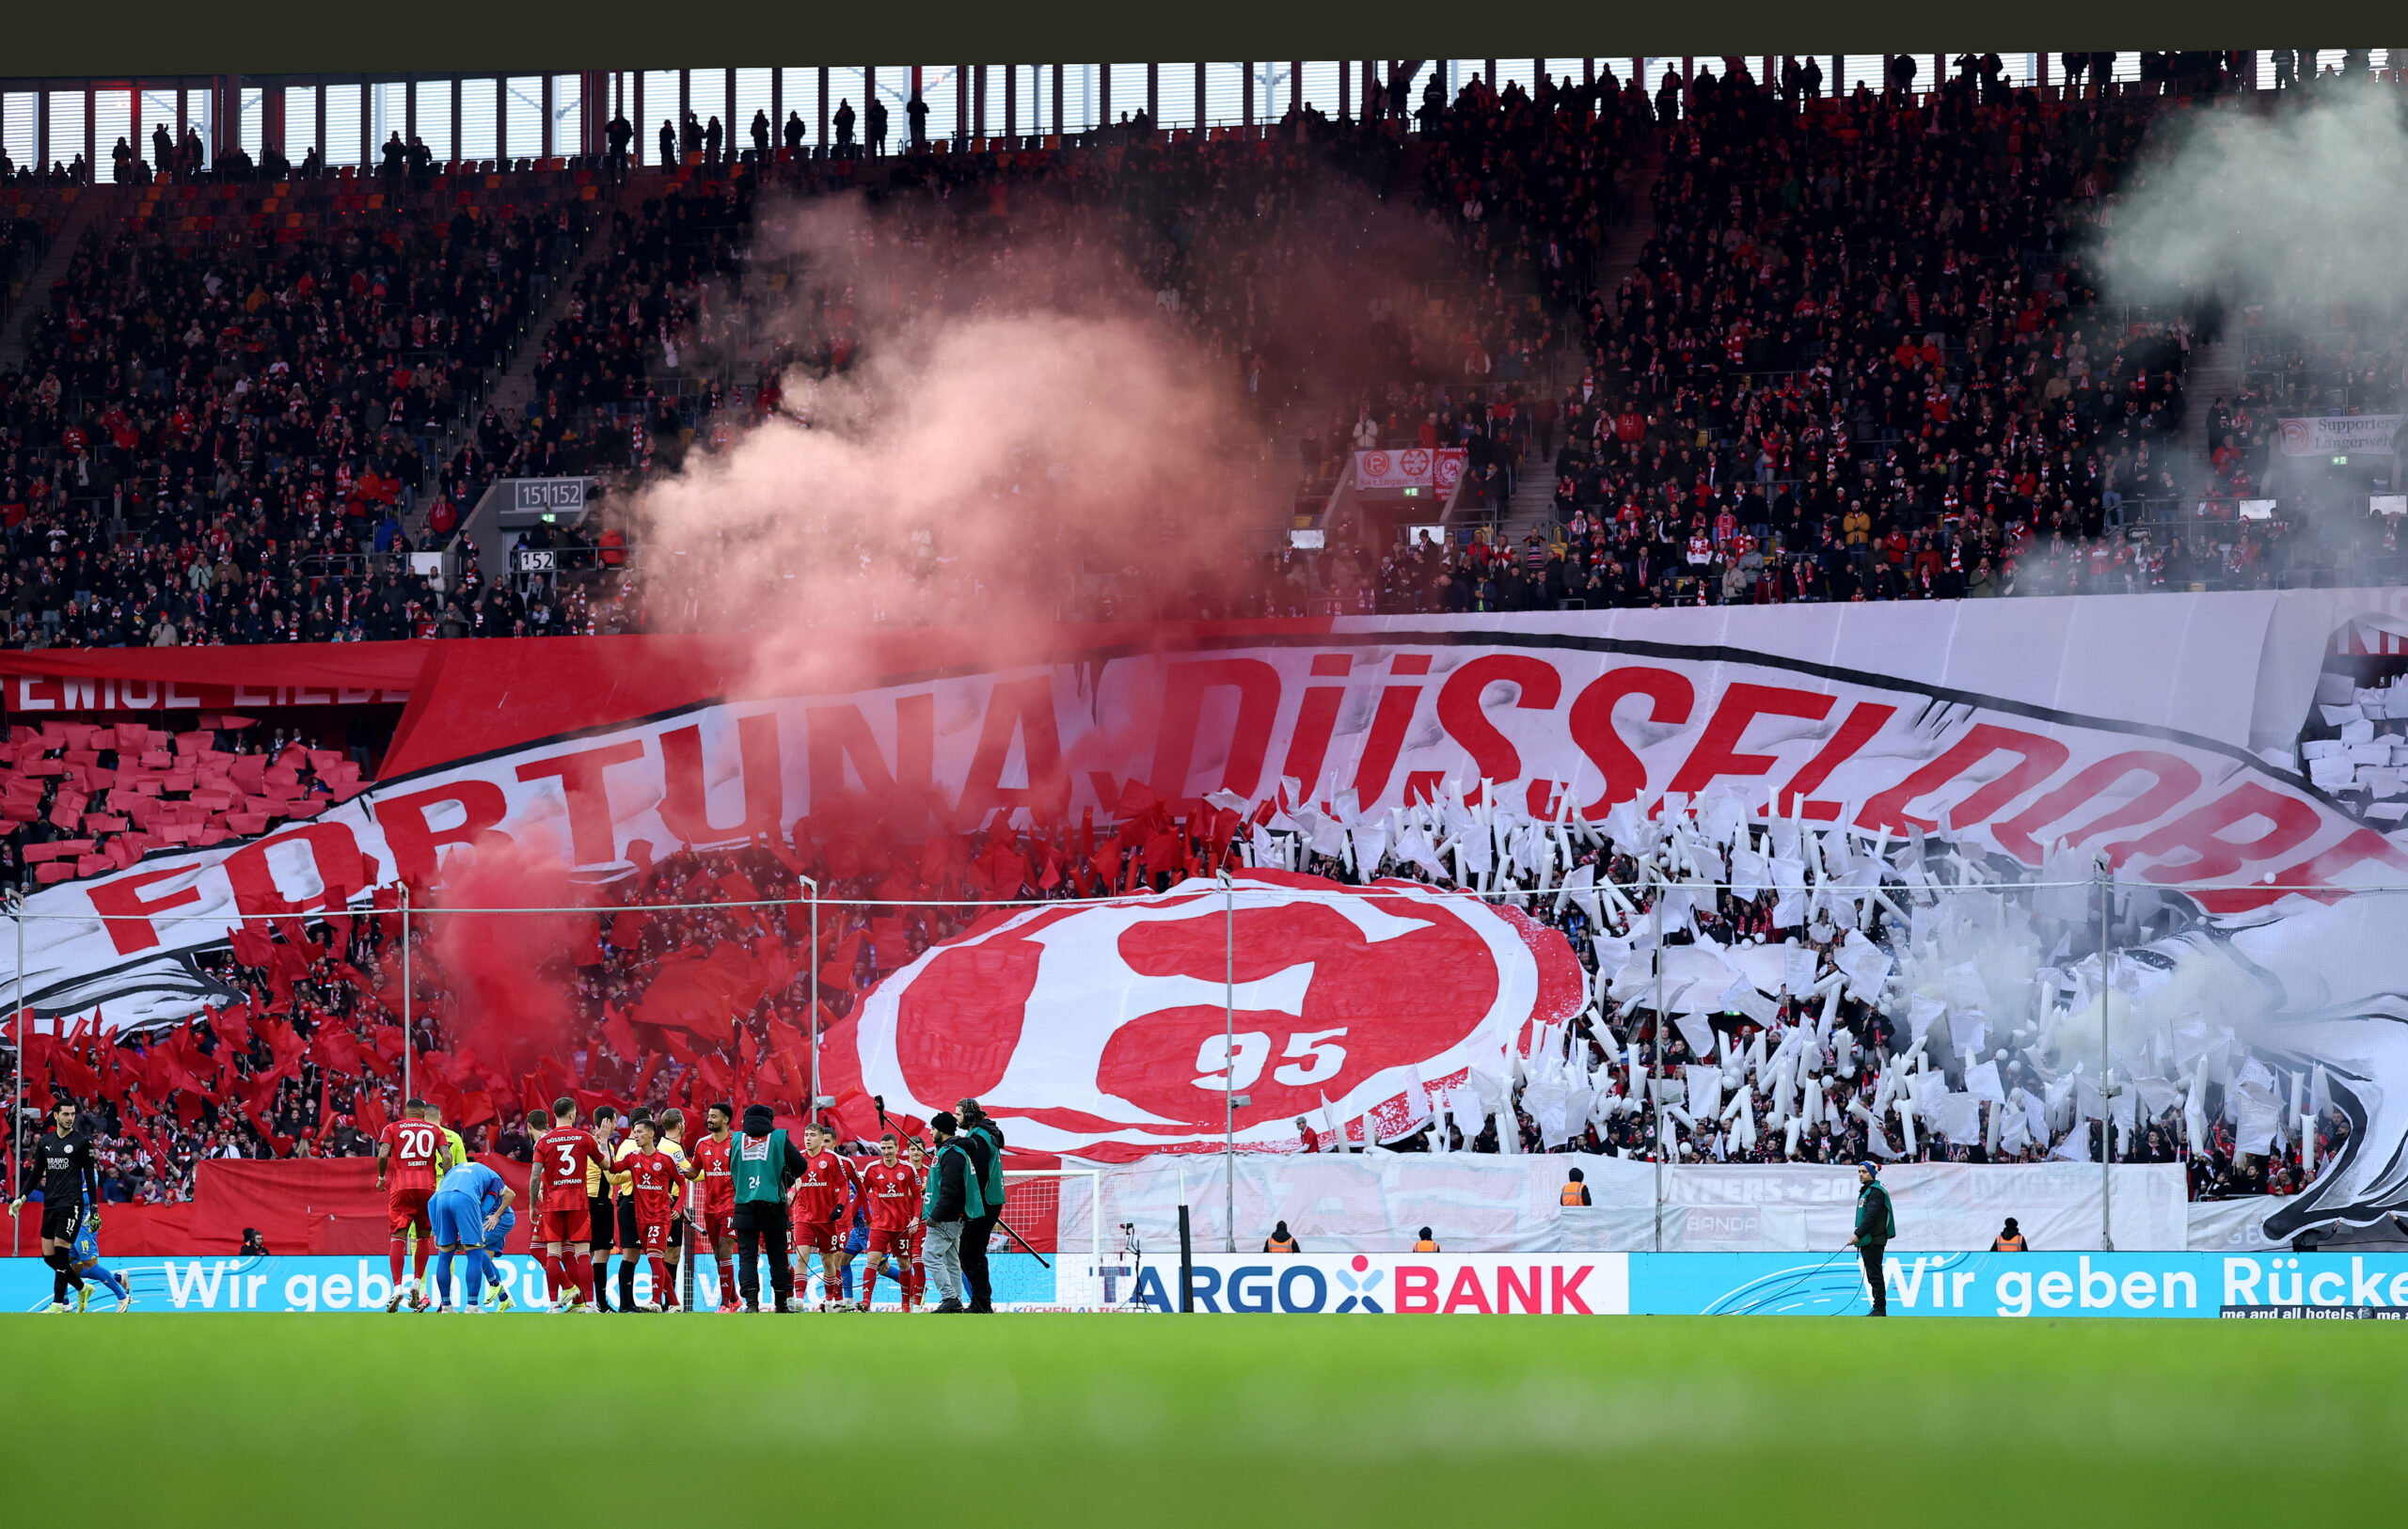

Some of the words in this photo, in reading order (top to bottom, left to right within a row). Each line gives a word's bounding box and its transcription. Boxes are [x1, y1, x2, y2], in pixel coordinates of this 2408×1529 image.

[2318, 418, 2398, 433] Supporters
[2315, 434, 2392, 449] Langerweh
[523, 486, 547, 505] 151
[551, 485, 579, 504] 152
[522, 553, 553, 569] 152
[87, 675, 1069, 955] FORTUNA
[1191, 1027, 1349, 1092] 95
[399, 1129, 435, 1159] 20
[546, 1135, 583, 1144] DÜSSELDORF
[557, 1143, 577, 1176] 3
[647, 1225, 660, 1238] 23
[1687, 1216, 1759, 1233] BANDA
[831, 1235, 838, 1246] 8
[839, 1232, 847, 1242] 6
[898, 1238, 910, 1250] 31
[164, 1258, 267, 1309] Wir
[1090, 1264, 1328, 1314] TARGO
[1394, 1265, 1596, 1315] BANK
[1858, 1254, 1975, 1309] Wir
[1995, 1255, 2197, 1316] geben
[2222, 1310, 2246, 1319] me
[2249, 1308, 2278, 1319] and
[2282, 1307, 2302, 1319] all
[2305, 1308, 2354, 1320] hotels
[2376, 1312, 2400, 1320] me
